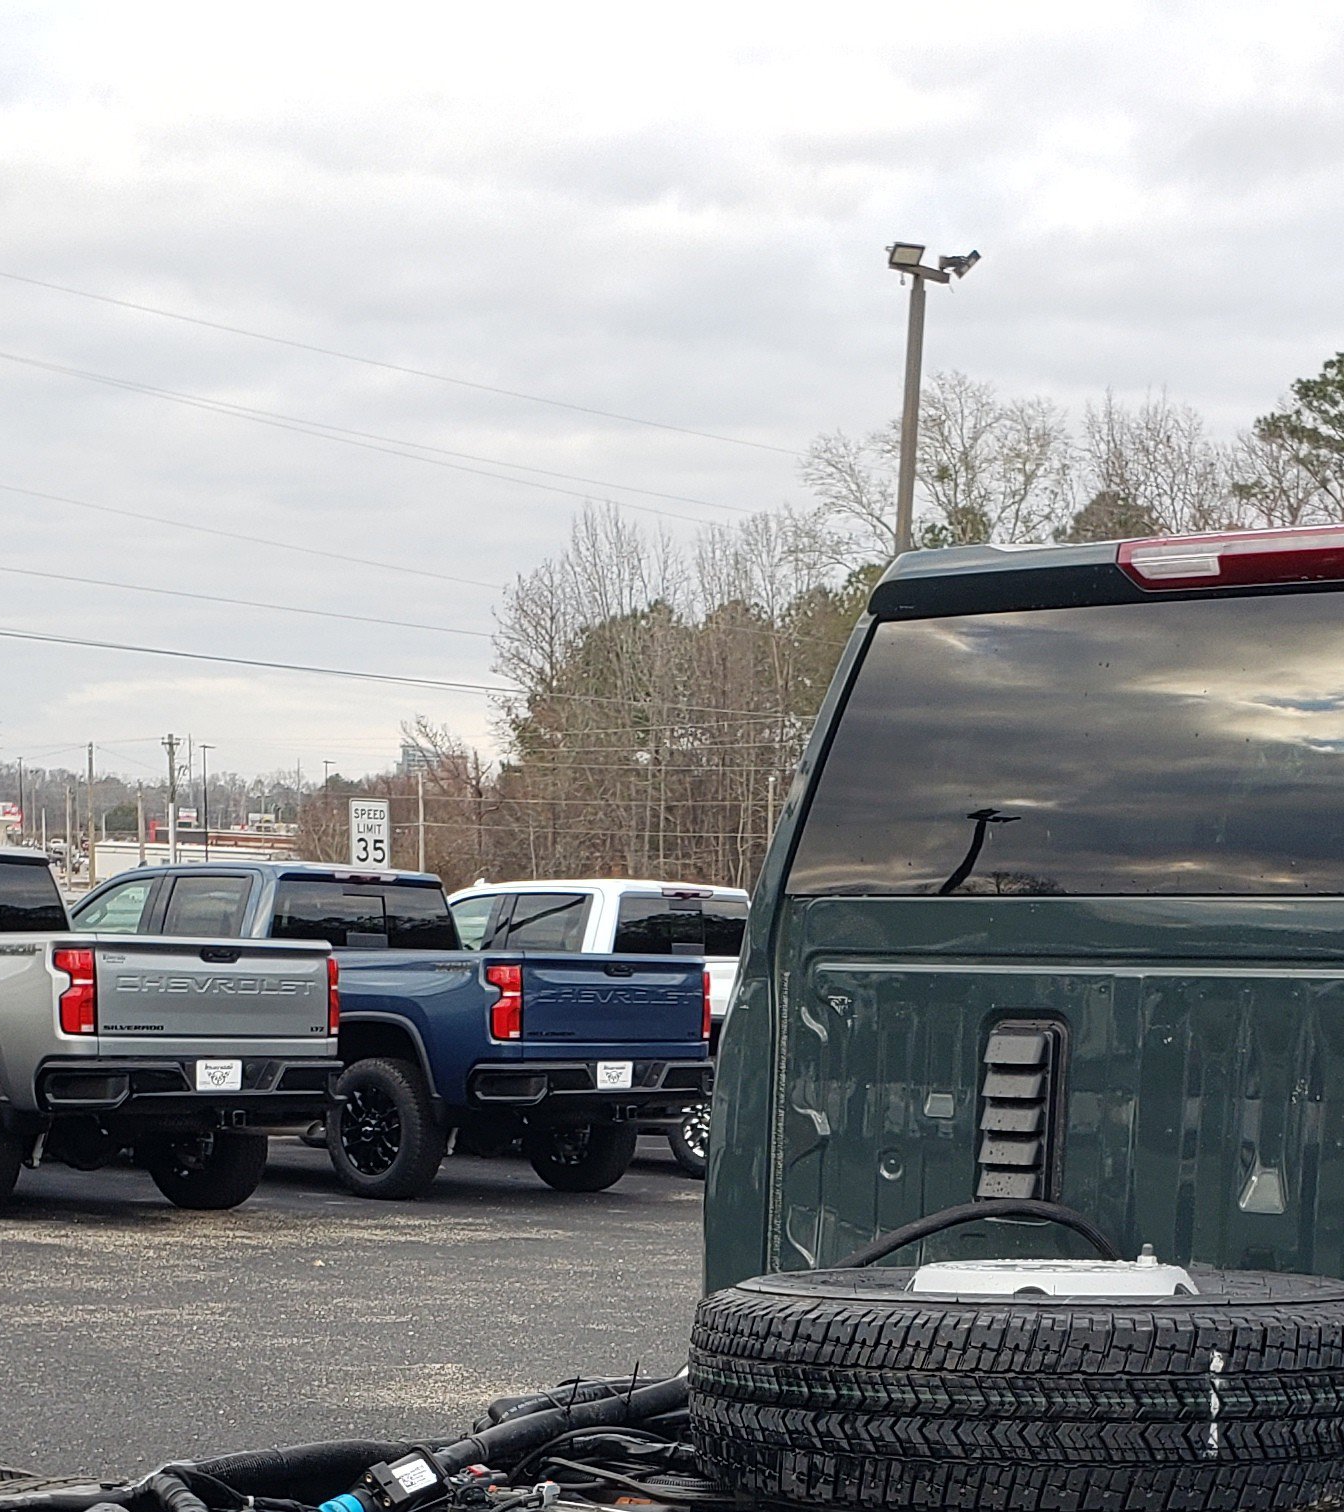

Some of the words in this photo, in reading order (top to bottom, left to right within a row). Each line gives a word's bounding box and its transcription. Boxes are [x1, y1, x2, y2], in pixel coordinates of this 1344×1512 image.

[353, 808, 386, 820] SPEED
[357, 823, 382, 834] LIMIT
[356, 837, 386, 863] 35
[116, 976, 316, 995] CHEVROLET
[537, 989, 703, 1005] CHEVROLET
